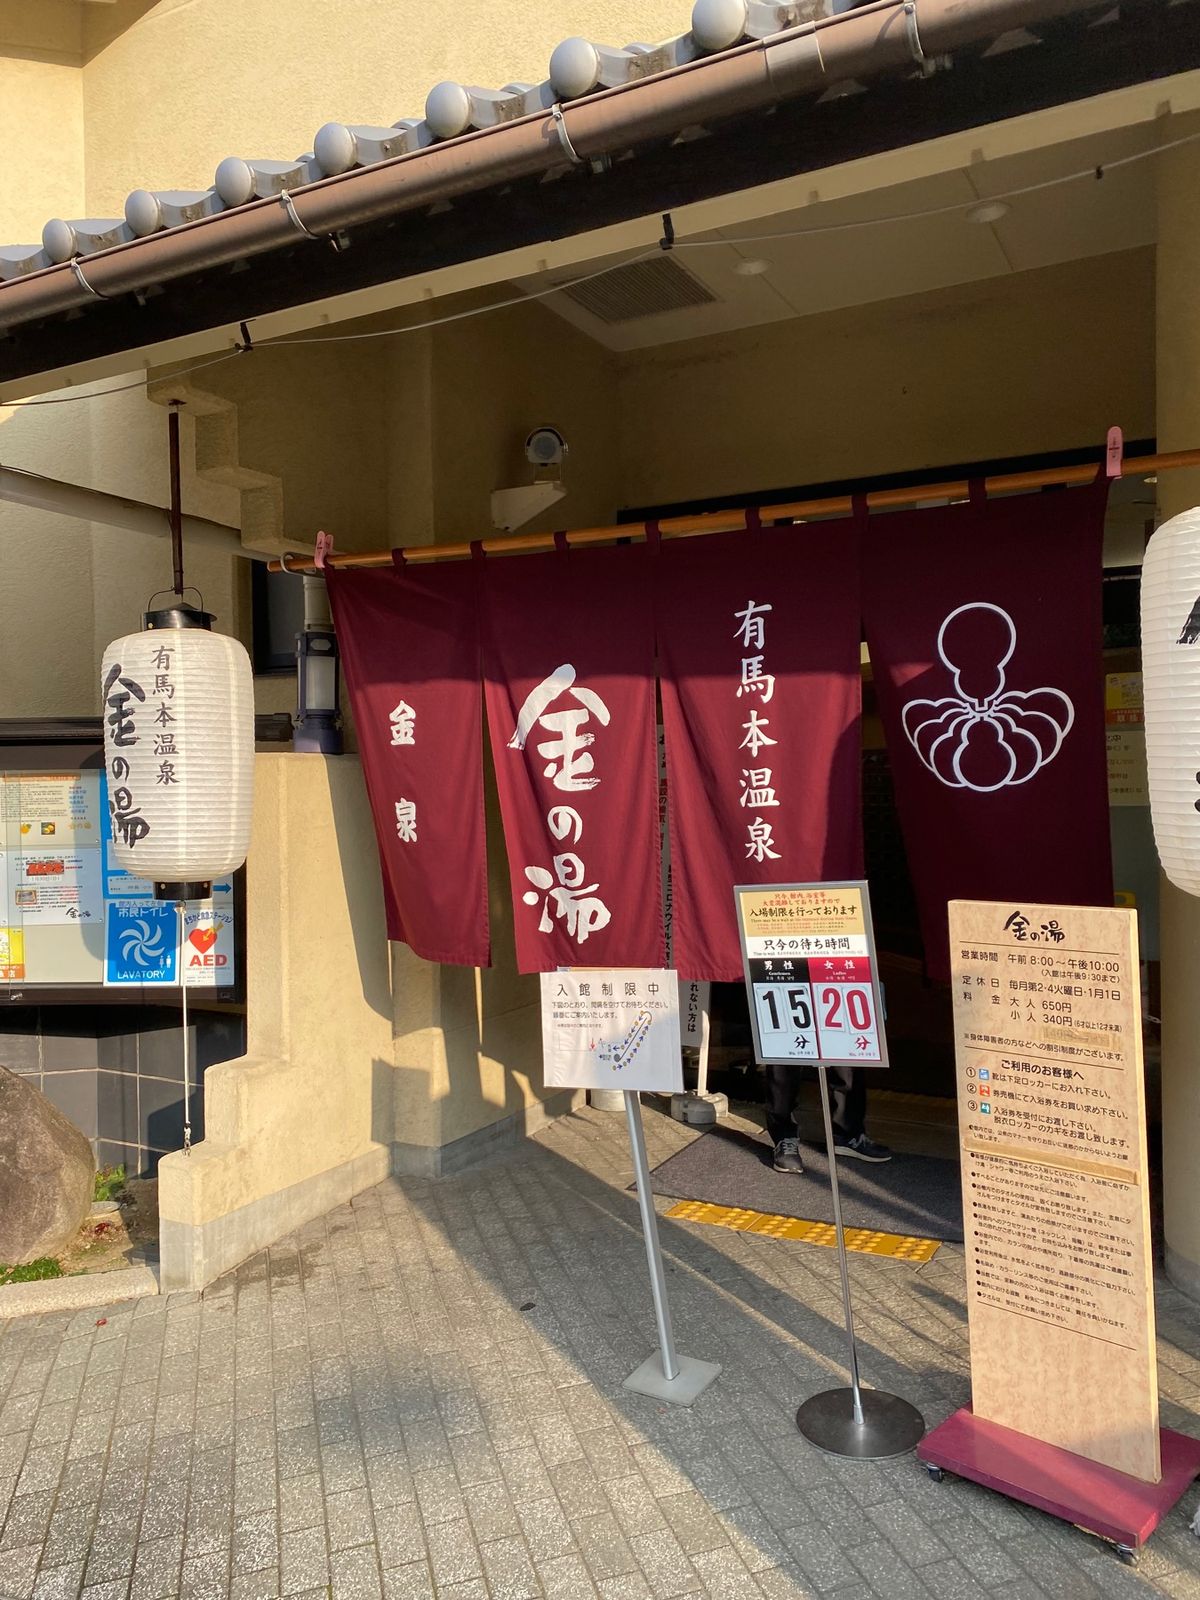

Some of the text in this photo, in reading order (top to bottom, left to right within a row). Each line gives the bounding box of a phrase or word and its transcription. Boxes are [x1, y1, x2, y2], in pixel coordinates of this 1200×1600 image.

[151, 645, 180, 786] 有馬本温泉
[732, 600, 783, 863] 有馬本温泉
[103, 663, 150, 849] 金の湯
[388, 699, 418, 843] 金泉
[506, 662, 611, 945] 金の湯
[118, 908, 168, 918] 市民トイレ
[750, 905, 857, 918] 入場制限を行っております
[1003, 910, 1066, 944] 金の湯
[764, 937, 850, 951] 只今の待ち時間
[189, 954, 228, 967] AED
[763, 960, 795, 971] 男性
[824, 959, 856, 970] 女性
[961, 950, 999, 963] 営業時間
[117, 970, 165, 979] LAVATORY
[961, 975, 1000, 988] 定休日
[556, 982, 660, 997] 入館制限中
[687, 979, 700, 1033] れない方は
[762, 989, 811, 1030] 15
[822, 987, 872, 1031] 20
[1009, 996, 1036, 1009] 大人
[1041, 1000, 1072, 1013] 650円
[1010, 1009, 1036, 1023] 小人
[1042, 1013, 1073, 1027] 340円
[793, 1034, 811, 1050] 分
[854, 1035, 872, 1051] 分
[1001, 1059, 1085, 1081] ご利用のお客様へ
[991, 1071, 1112, 1100] 靴は下足ロッカーにお入れ下さい。
[992, 1089, 1129, 1120] 券売機にて入浴券をお買い求め下さい。
[993, 1105, 1096, 1132] 入浴券を受付にお渡し下さい。
[993, 1116, 1130, 1149] 脱衣ロッカーのカギをお渡し致します。
